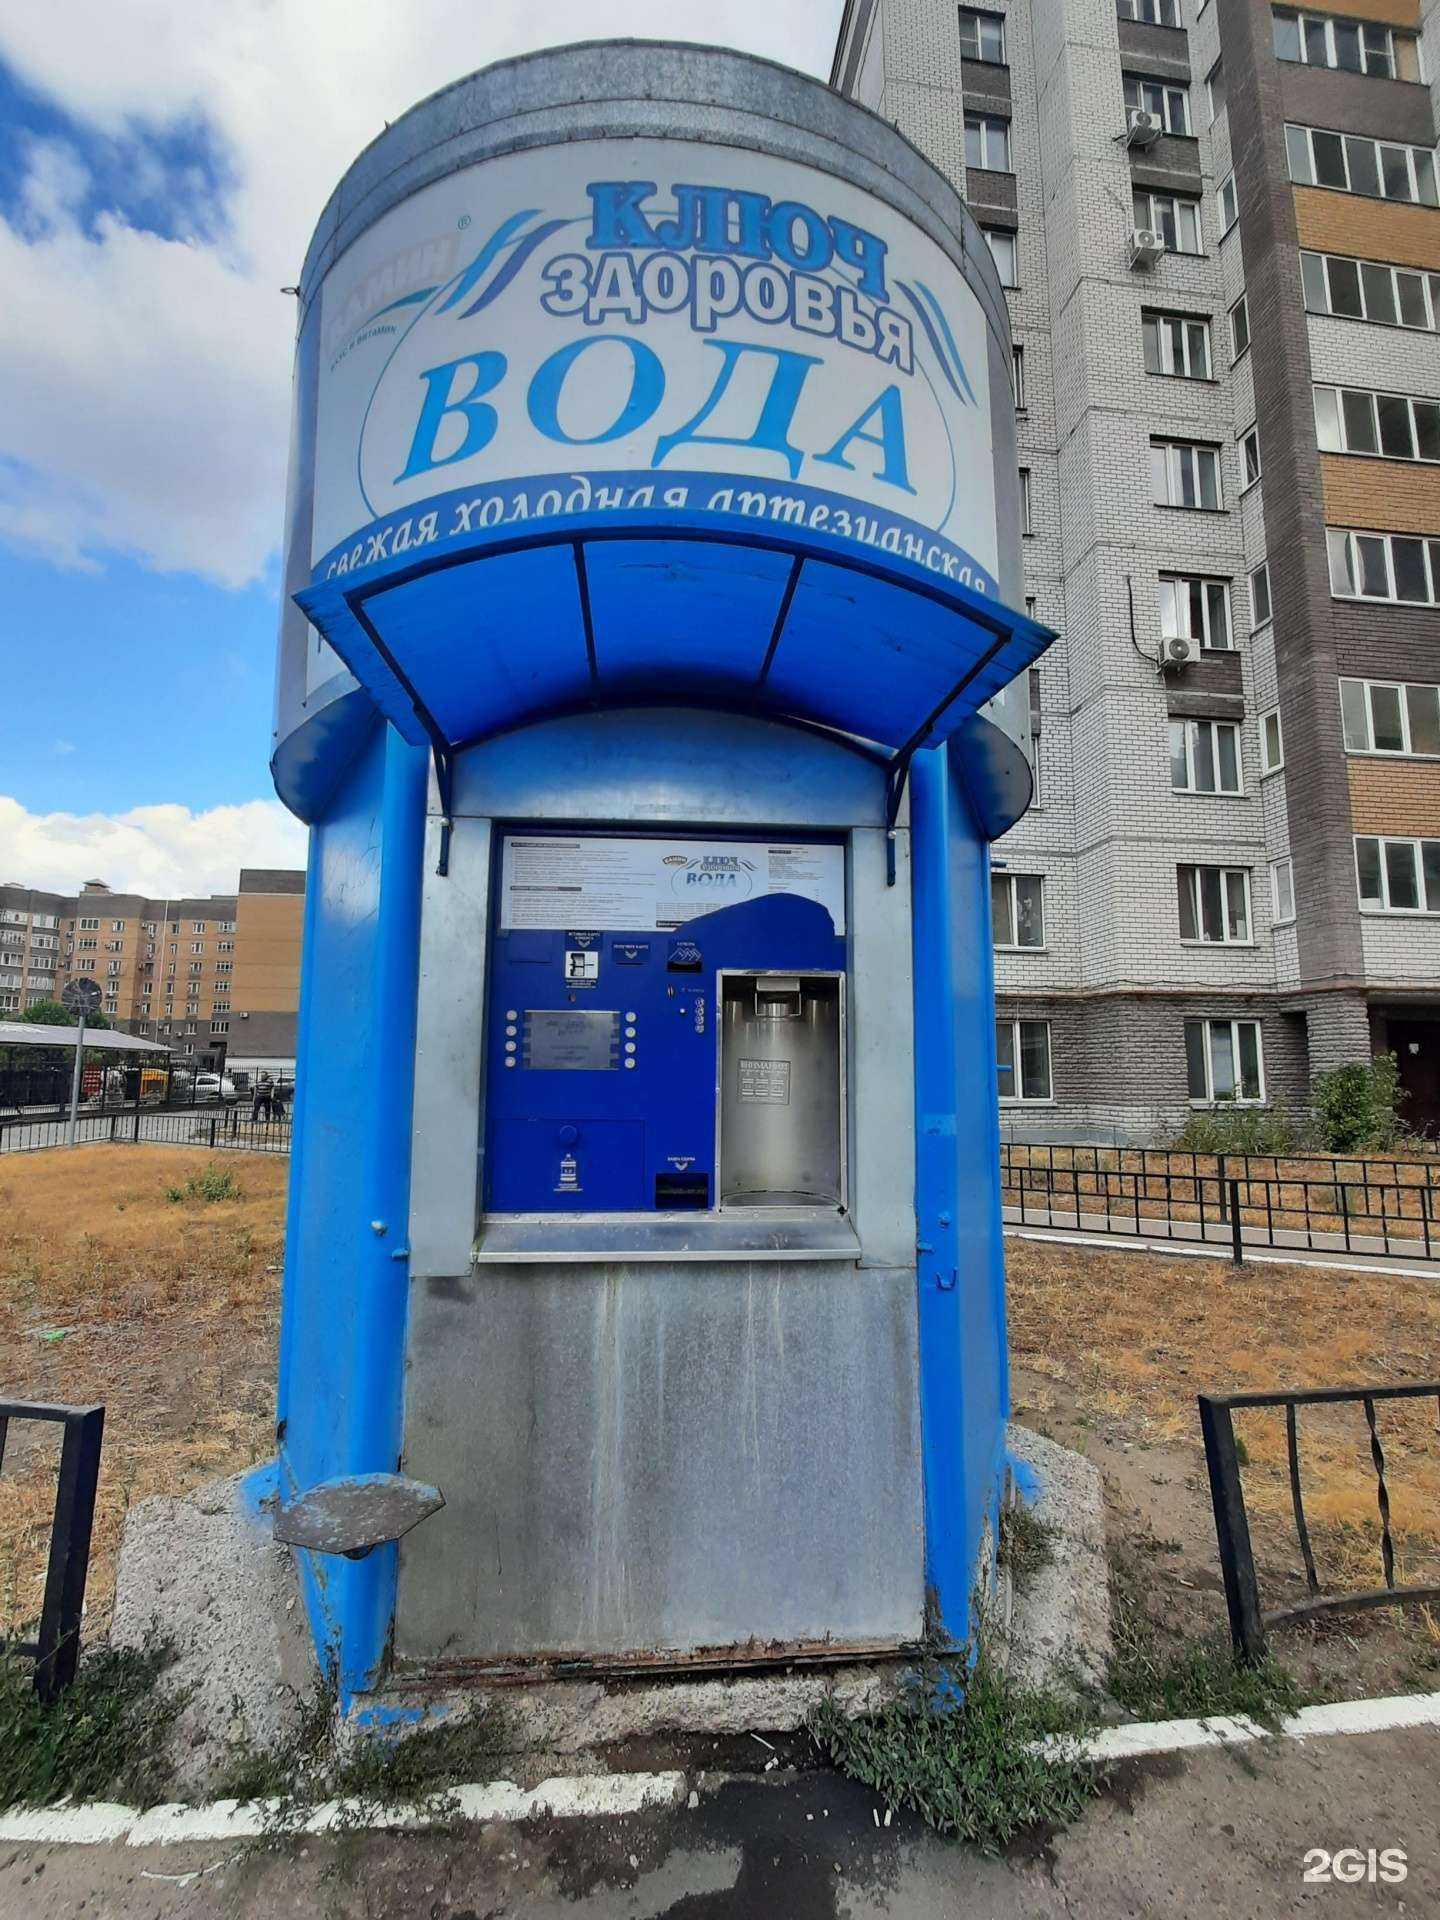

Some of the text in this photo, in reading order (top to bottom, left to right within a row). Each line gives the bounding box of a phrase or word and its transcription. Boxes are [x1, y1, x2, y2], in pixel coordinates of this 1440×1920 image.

[586, 180, 889, 304] КЛЮЧ
[541, 247, 915, 375] ЗДОРОВЬЯ
[394, 334, 918, 495] ВОДА
